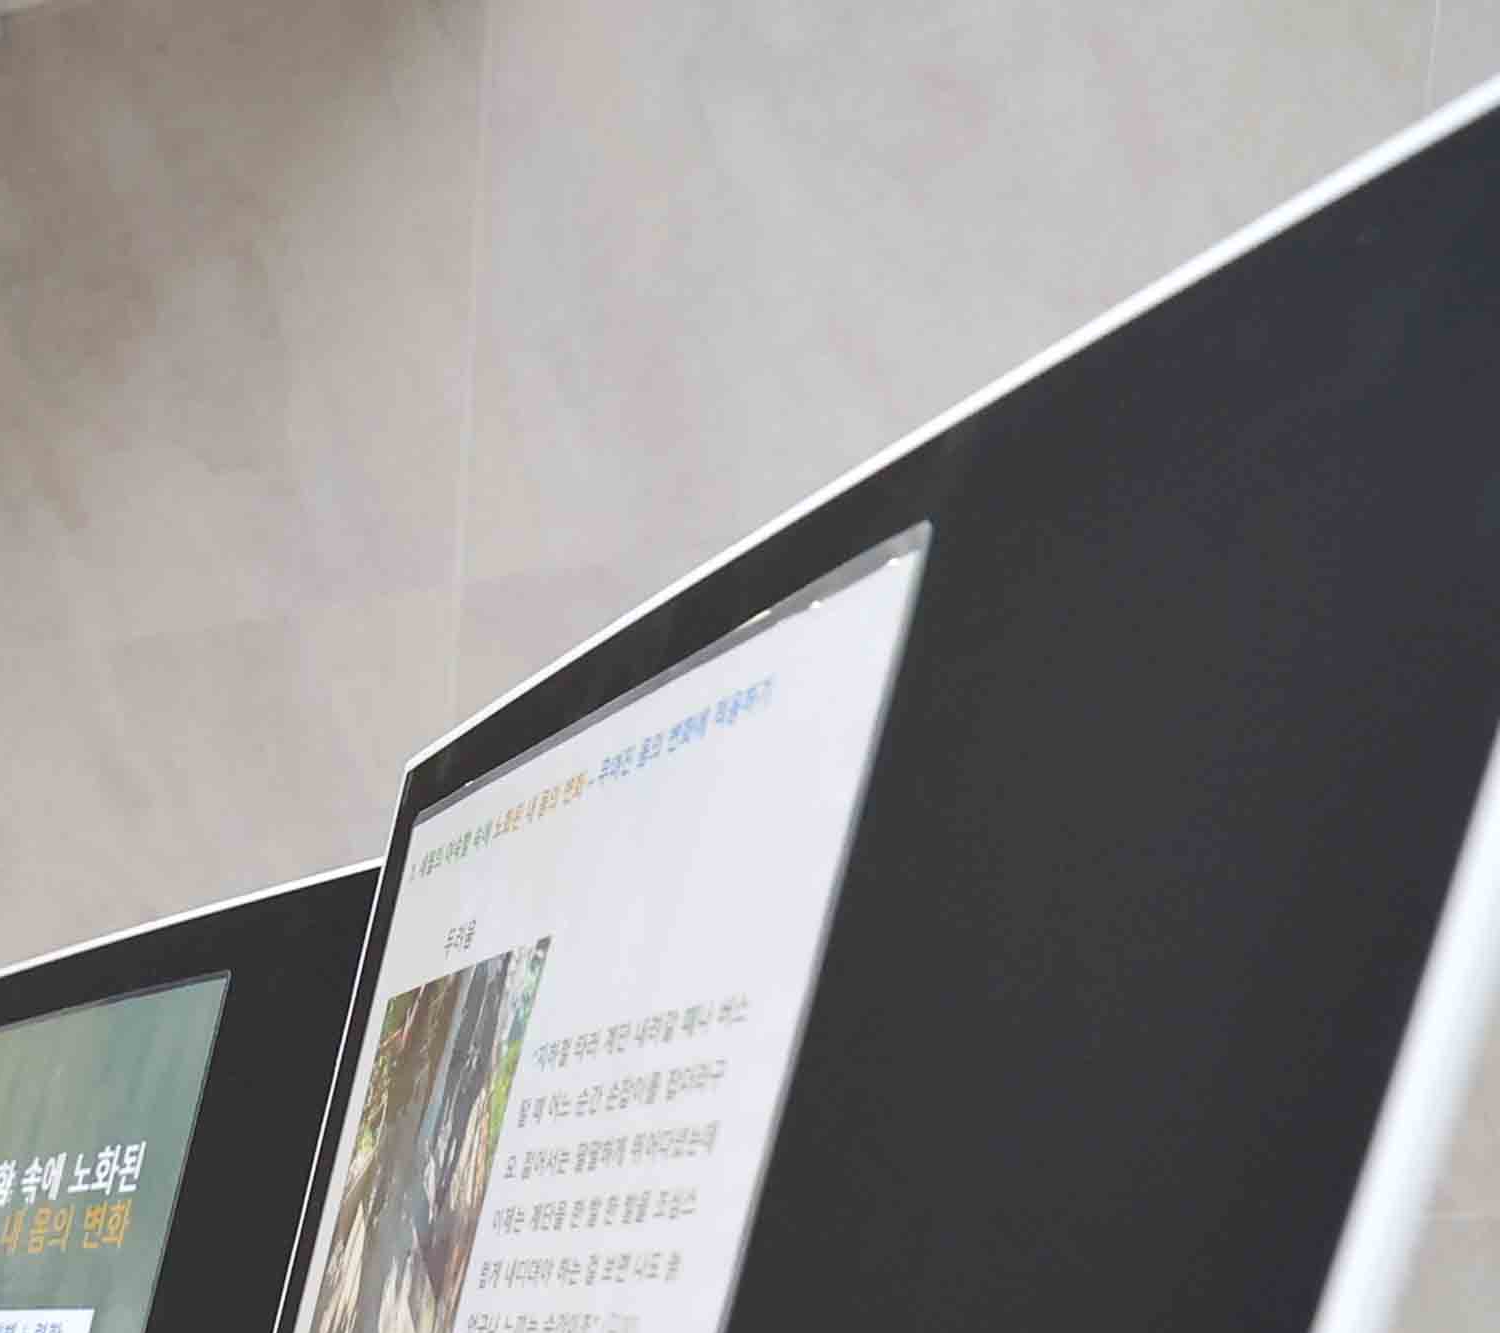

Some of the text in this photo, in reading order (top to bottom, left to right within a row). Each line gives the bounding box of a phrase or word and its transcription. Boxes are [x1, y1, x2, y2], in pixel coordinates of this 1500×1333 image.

[21, 1153, 64, 1202] 속에
[72, 1141, 148, 1196] 노화된
[28, 1202, 73, 1254] 몸의
[84, 1198, 133, 1249] 변화
